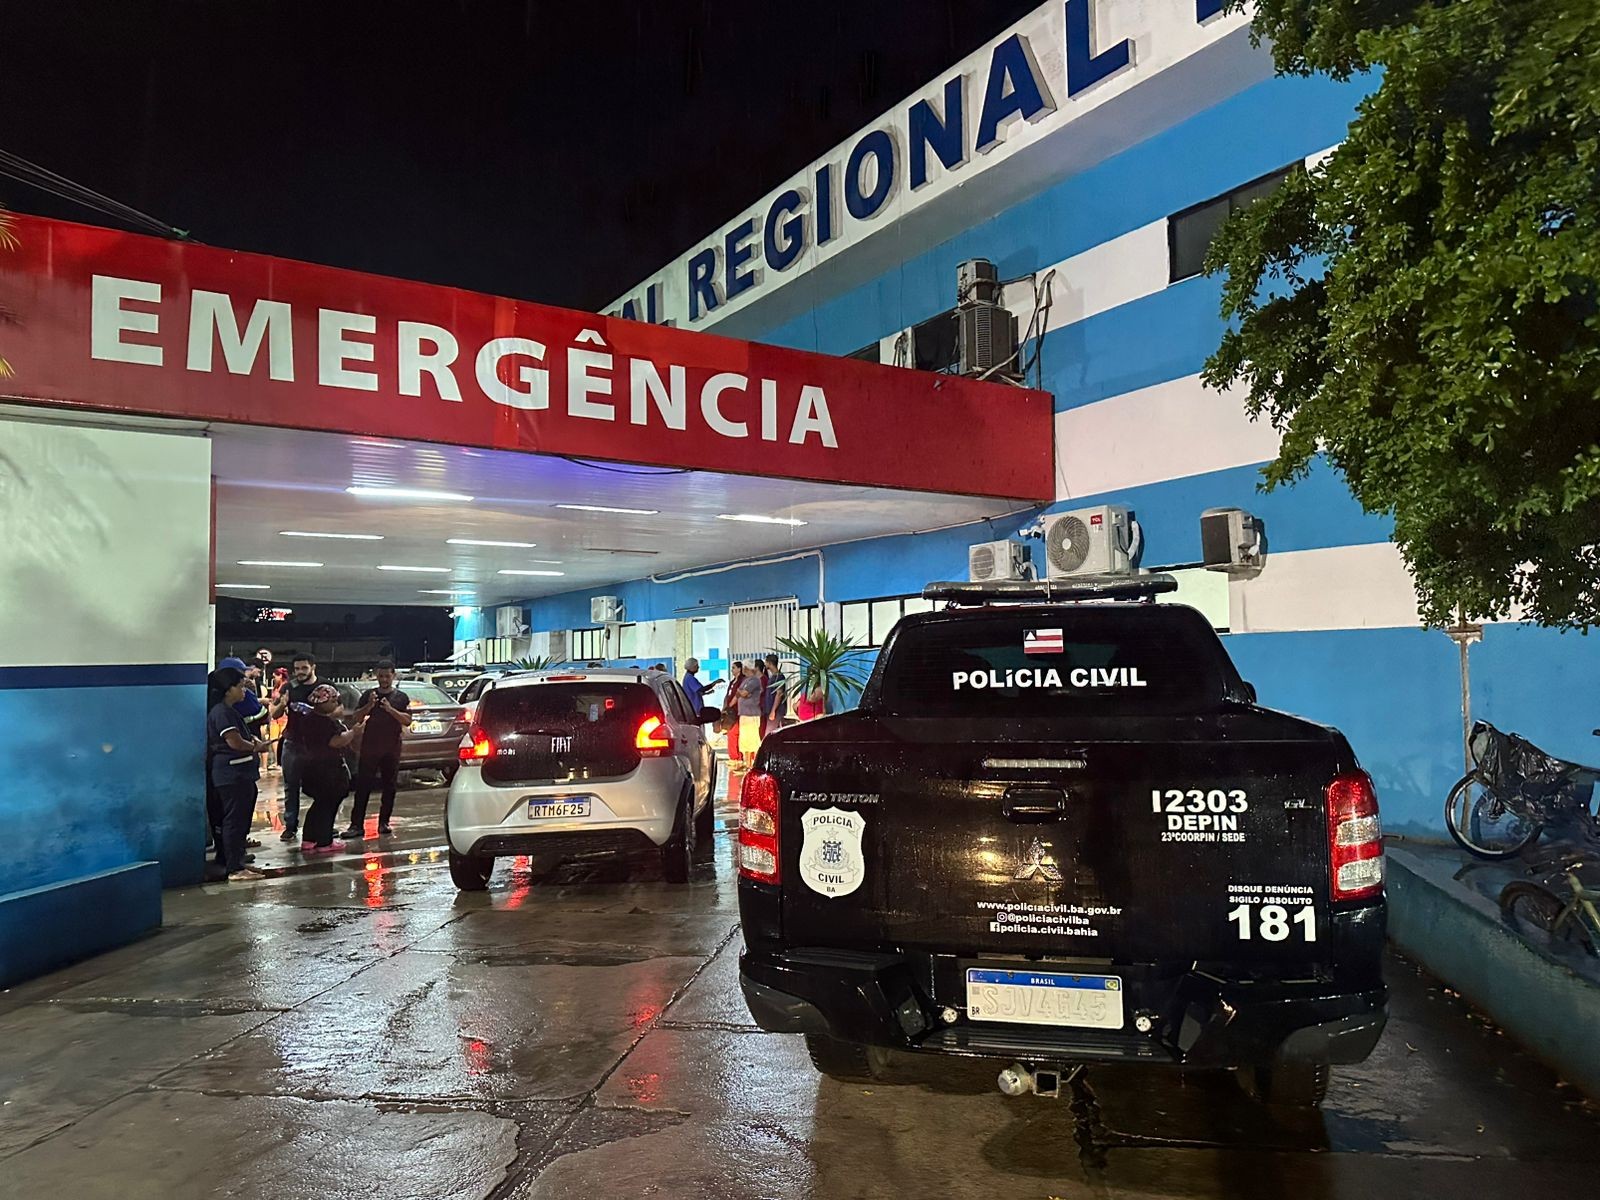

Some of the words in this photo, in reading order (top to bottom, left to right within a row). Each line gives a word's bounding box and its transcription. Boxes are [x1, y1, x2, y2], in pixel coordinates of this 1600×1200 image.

[688, 0, 1135, 323] REGIONAL
[91, 274, 839, 449] EMERGÊNCIA
[953, 668, 1063, 690] POLÍCIA
[1070, 668, 1147, 687] CIVIL
[551, 737, 572, 753] FIAT
[829, 792, 880, 804] TRITON
[534, 803, 584, 817] RTM6F25
[813, 815, 853, 828] POLÍCIA
[1167, 814, 1238, 831] DEPIN
[1222, 833, 1246, 842] SEDE
[818, 873, 845, 883] CIVIL
[1228, 885, 1263, 893] DISQUE
[1264, 884, 1314, 894] DENÚNCIA
[1229, 896, 1260, 904] SIGILO
[1262, 896, 1313, 905] ABSOLUTO
[976, 901, 1123, 916] www.policiacivil.ba.gov.br
[1007, 912, 1090, 926] @policiacivilba
[1228, 904, 1317, 942] 181
[1030, 977, 1056, 986] BRASIL
[971, 1006, 981, 1016] BR
